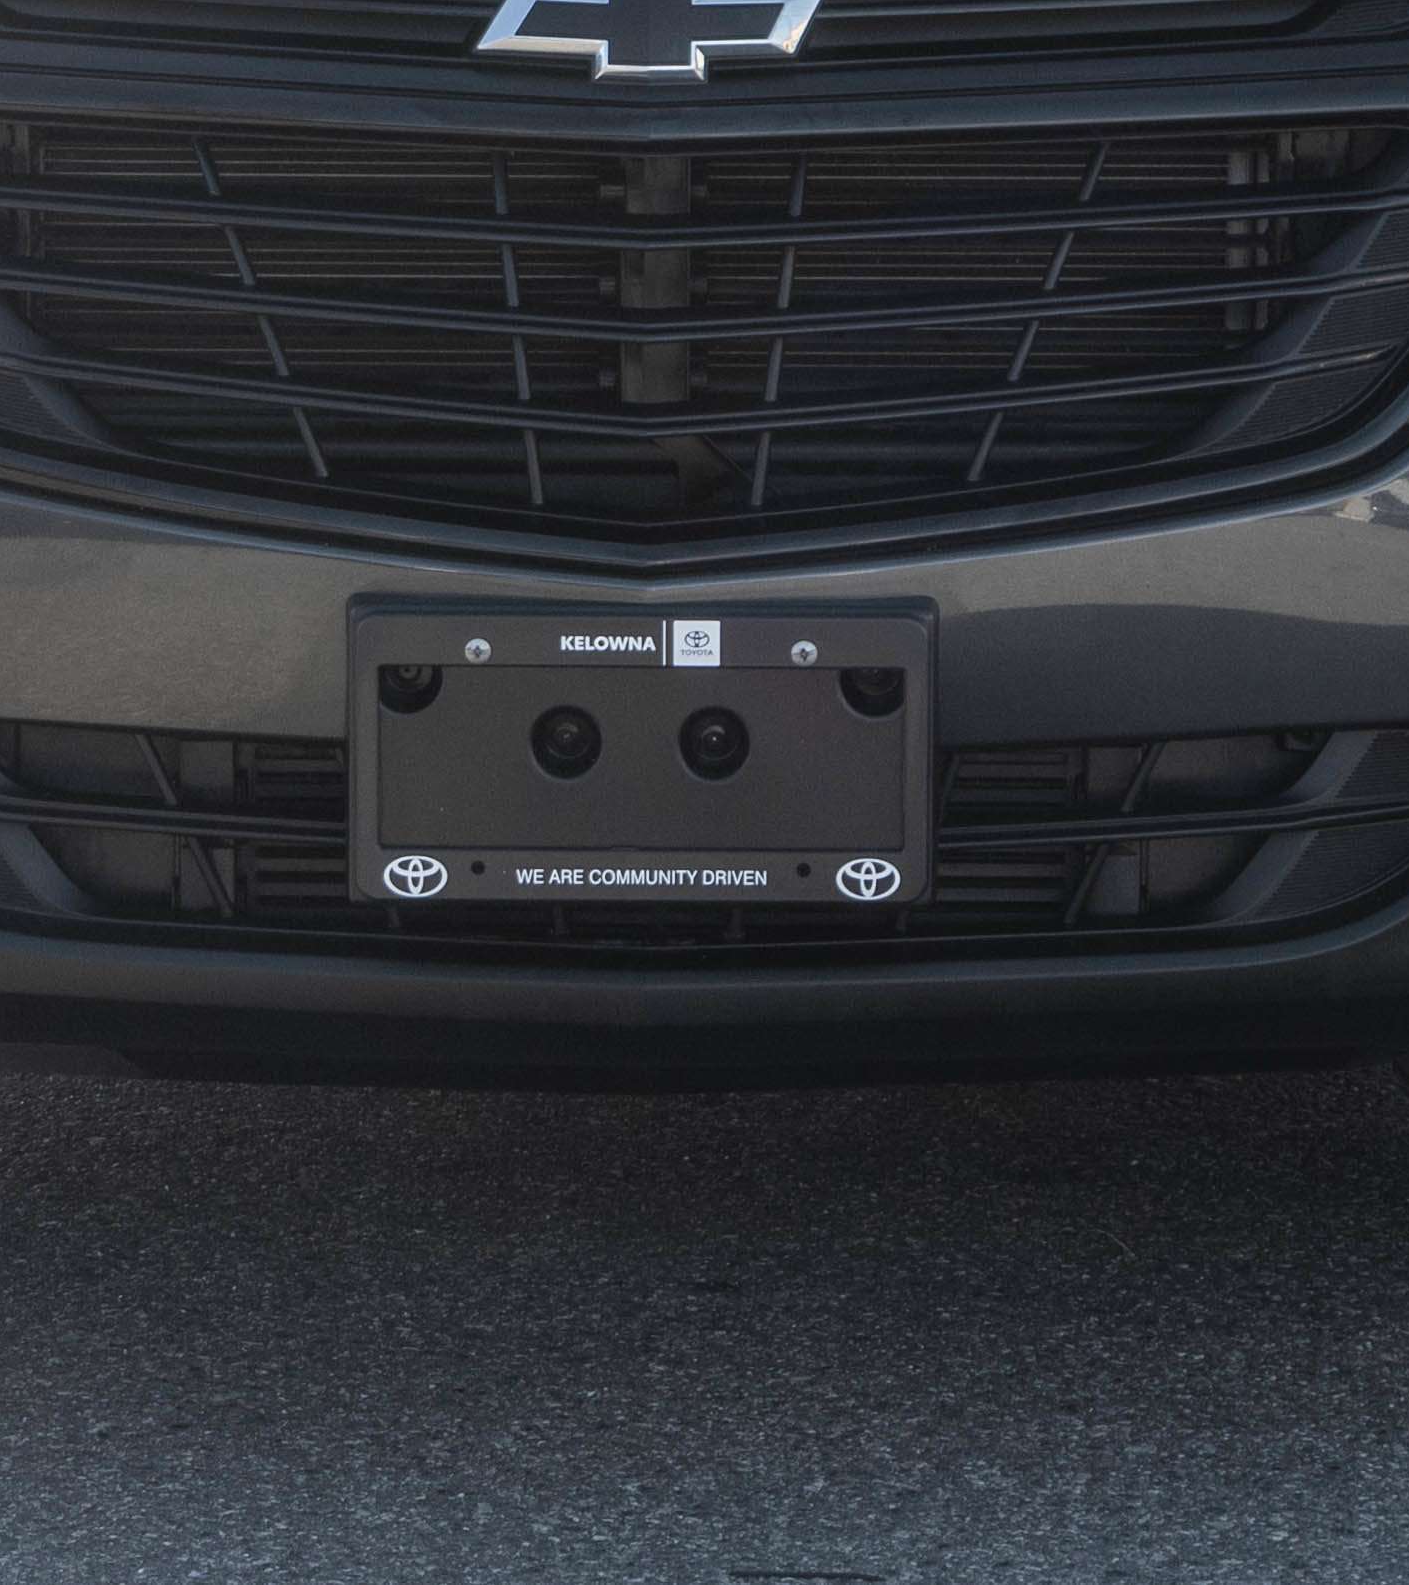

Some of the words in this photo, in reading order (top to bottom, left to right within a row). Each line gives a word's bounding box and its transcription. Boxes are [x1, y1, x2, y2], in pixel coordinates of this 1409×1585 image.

[560, 635, 657, 652] KELOWNA
[516, 868, 545, 885] WE
[548, 868, 584, 885] ARE
[589, 869, 698, 886] COMMUNITY
[702, 870, 768, 886] DRIVEN
